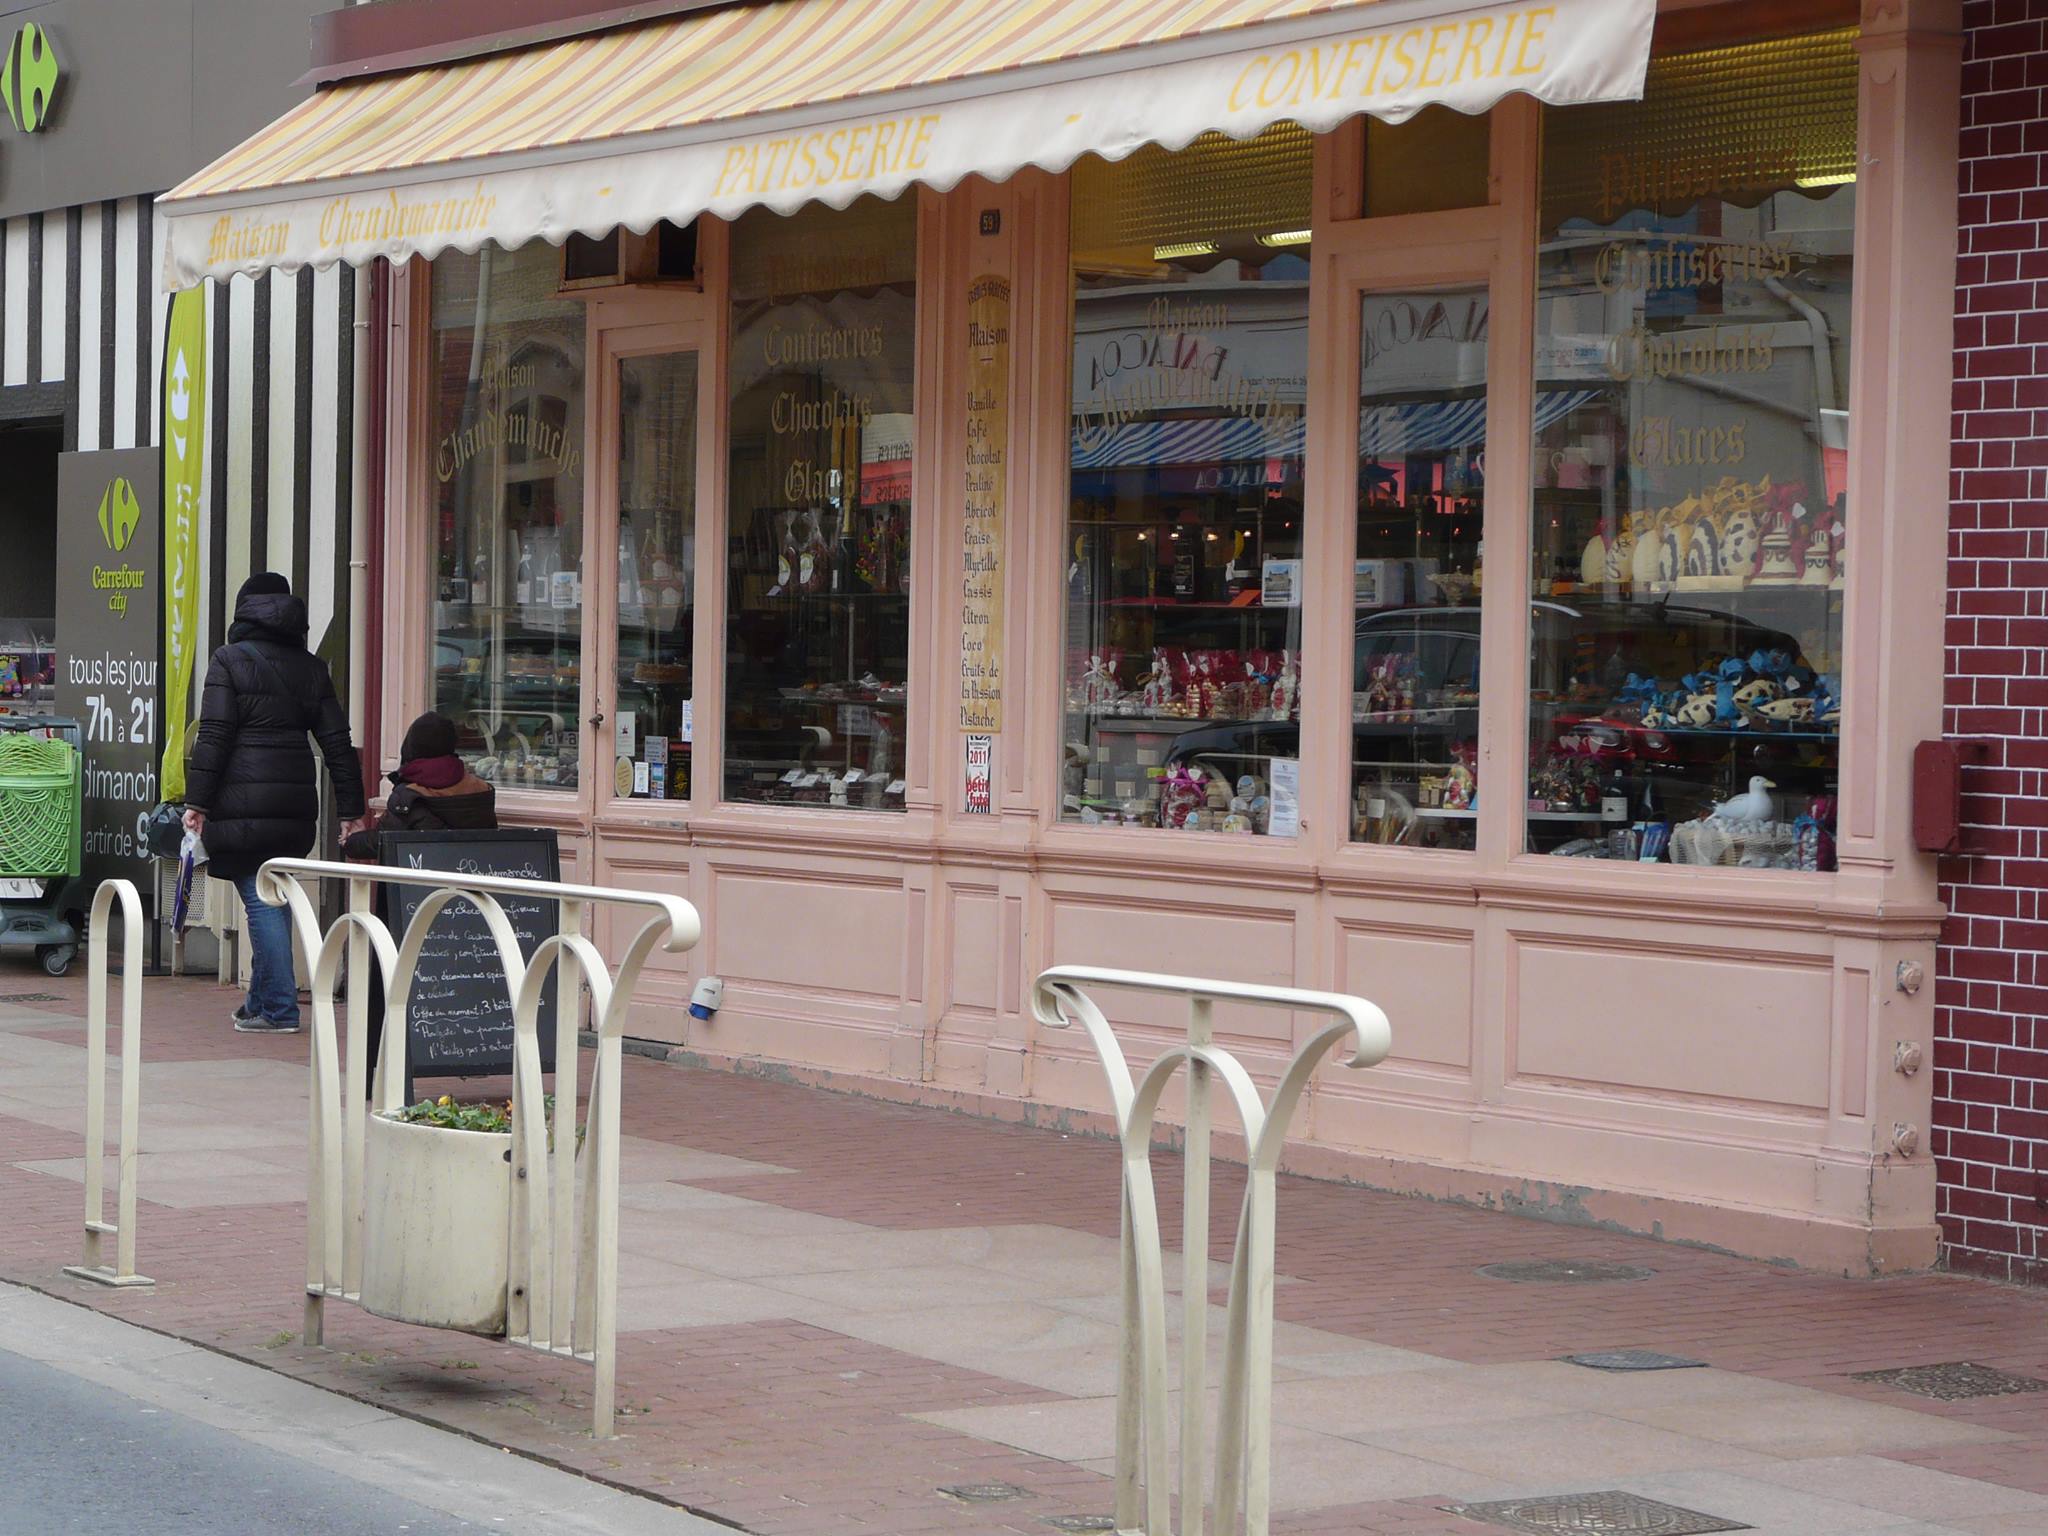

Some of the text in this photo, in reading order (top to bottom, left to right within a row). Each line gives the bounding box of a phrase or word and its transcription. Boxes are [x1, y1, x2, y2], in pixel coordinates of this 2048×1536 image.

[1228, 5, 1557, 113] CONFISERIE
[710, 113, 941, 198] PATISSERIE
[207, 214, 290, 266] Maison
[763, 320, 885, 367] Confiseries
[969, 321, 1008, 348] Maison
[967, 388, 998, 411] Vanille
[771, 390, 873, 441] Chocolats
[967, 418, 987, 443] Café
[1629, 414, 1748, 469] Glaces
[966, 444, 1001, 465] Chocolat
[965, 499, 996, 519] Abricot
[964, 525, 991, 545] Fraise
[92, 563, 145, 589] Carrefour
[963, 551, 999, 578] Myrtille
[963, 579, 993, 598] Cassis
[108, 591, 128, 619] city
[962, 605, 990, 625] Citron
[962, 631, 982, 651] Coco
[69, 653, 103, 684] tous
[105, 650, 127, 685] les
[961, 658, 999, 678] Fruits de
[961, 681, 970, 699] la
[86, 693, 114, 743] 7h
[117, 719, 125, 743] à
[960, 705, 995, 727] Pistache
[970, 750, 987, 764] 2011
[85, 823, 113, 855] artir
[114, 825, 132, 857] de
